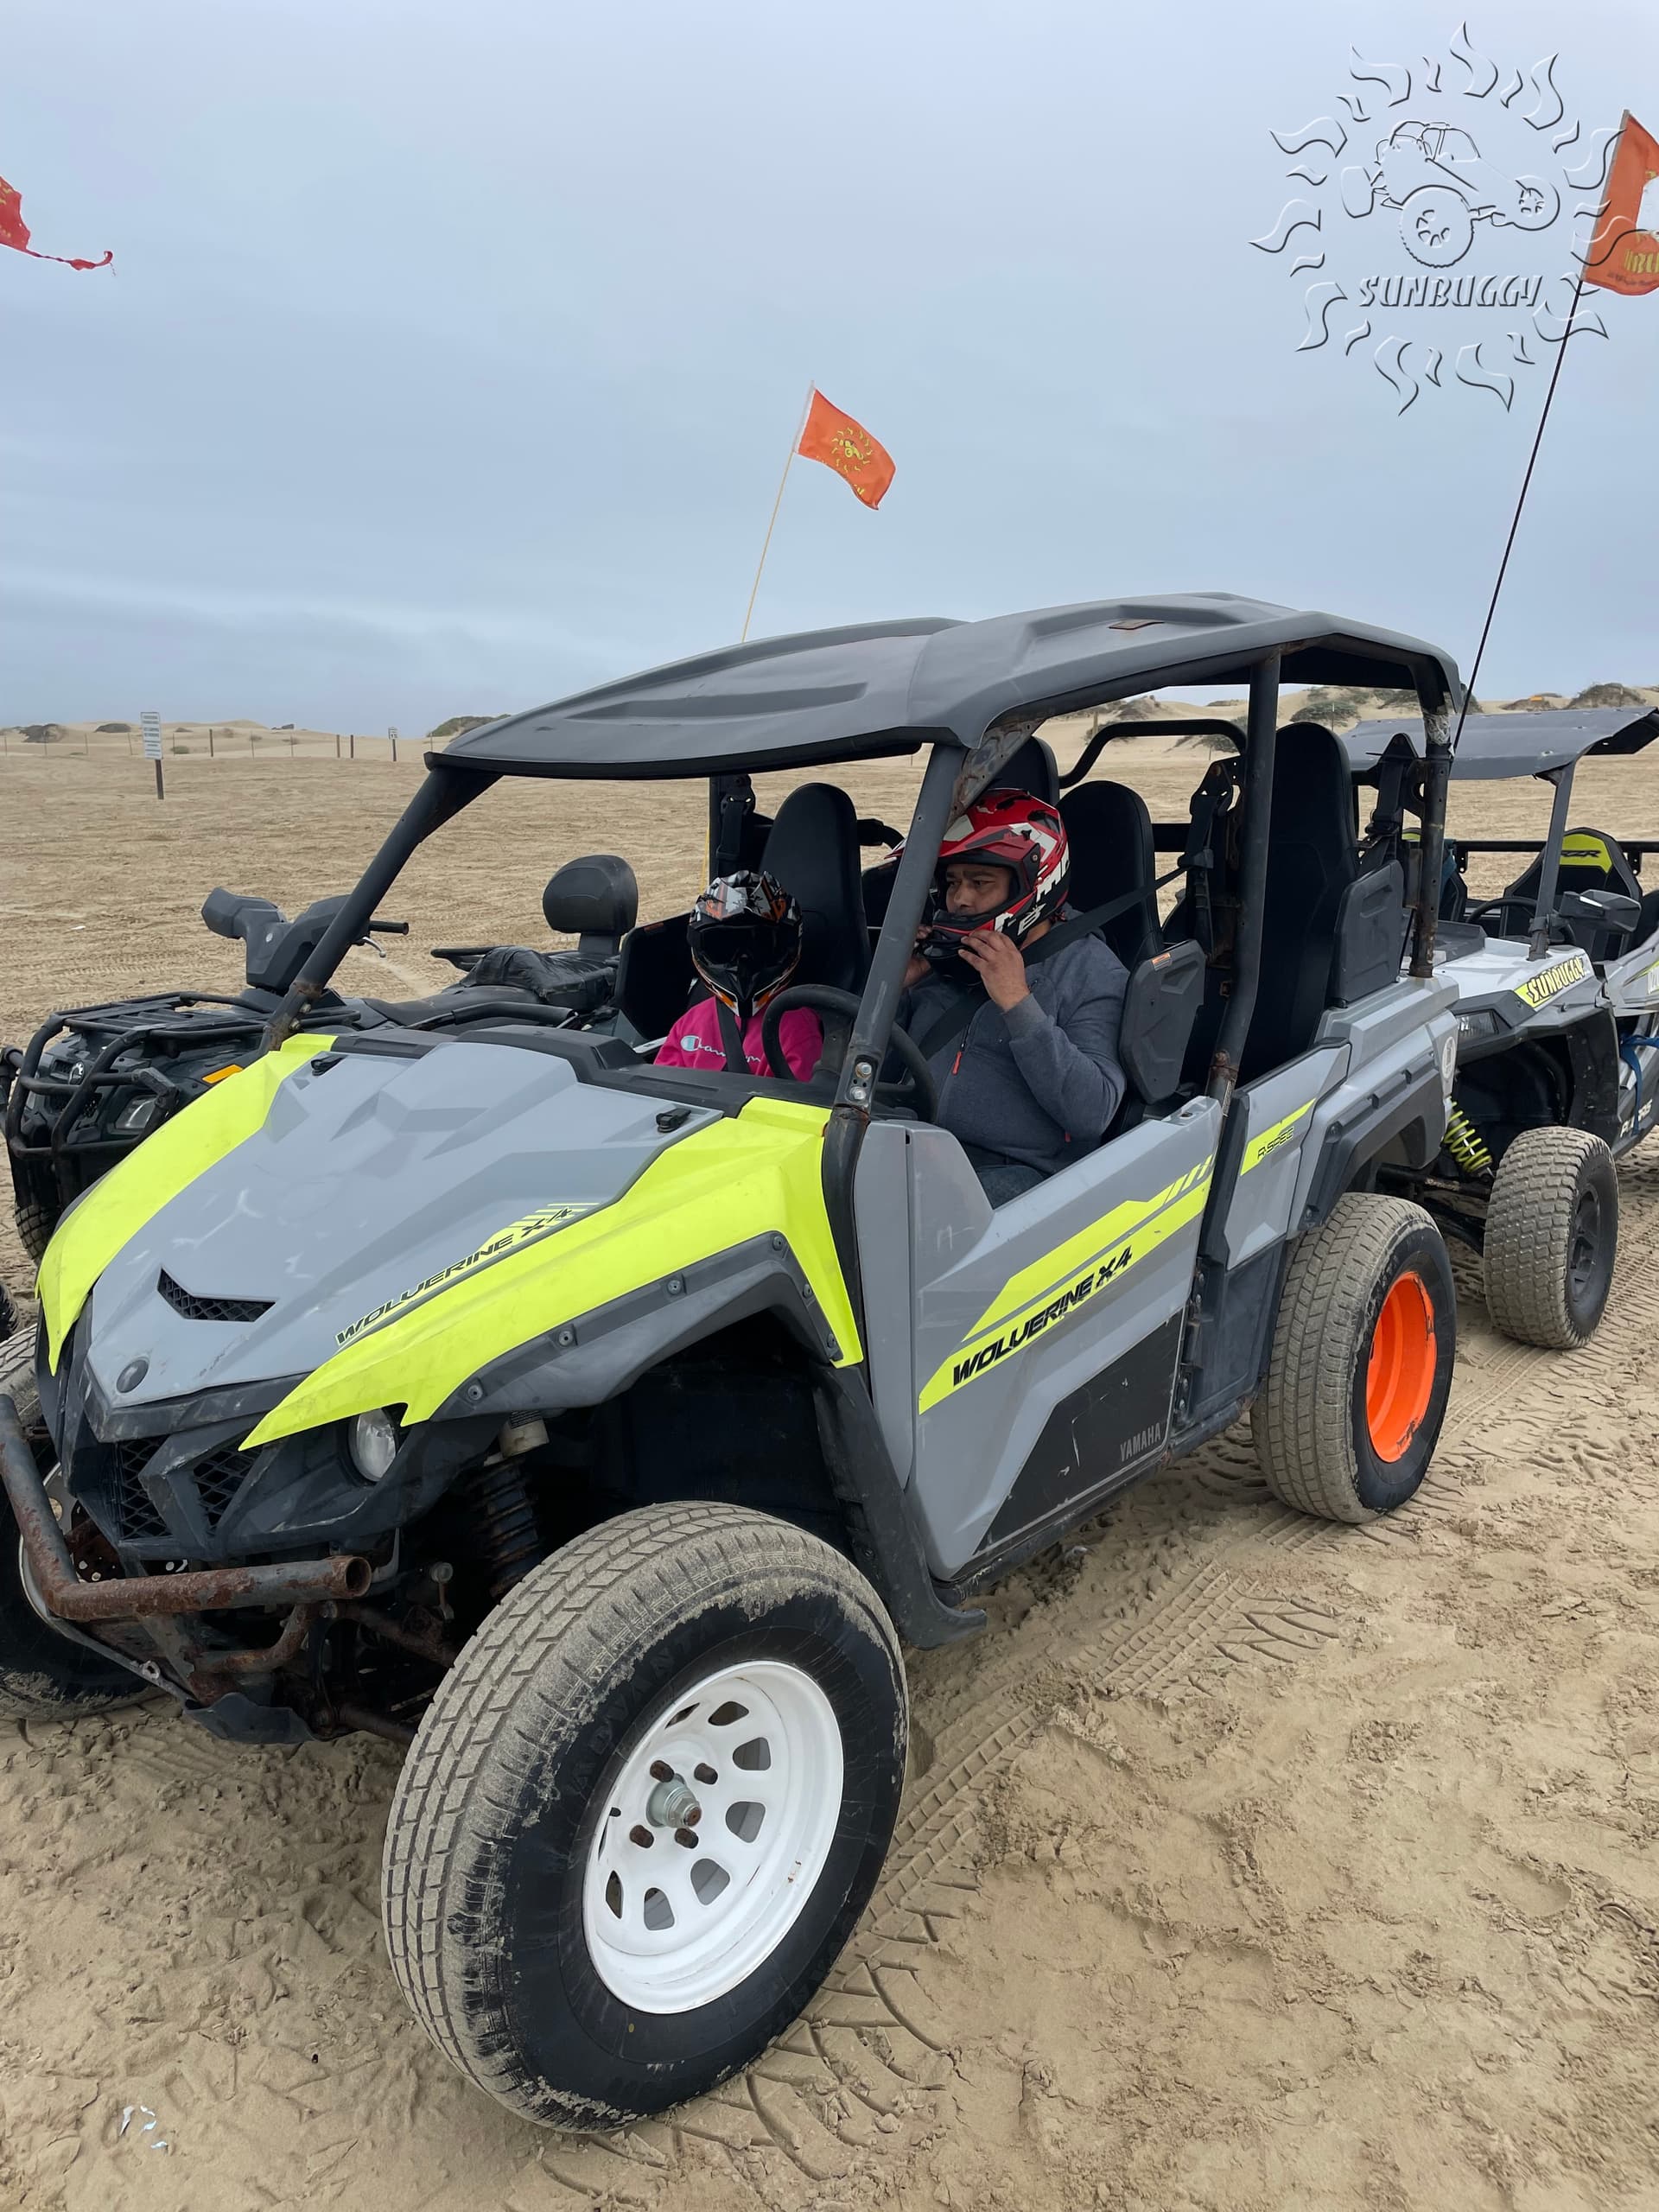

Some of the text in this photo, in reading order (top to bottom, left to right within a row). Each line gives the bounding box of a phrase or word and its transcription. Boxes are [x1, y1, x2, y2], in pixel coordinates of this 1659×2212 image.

[1527, 955, 1586, 1004] SUNBUGGY
[336, 1207, 572, 1345] WOLVERINE X4
[954, 1245, 1133, 1388] WOLVERINE X4
[1120, 1422, 1160, 1462] YAMAHA
